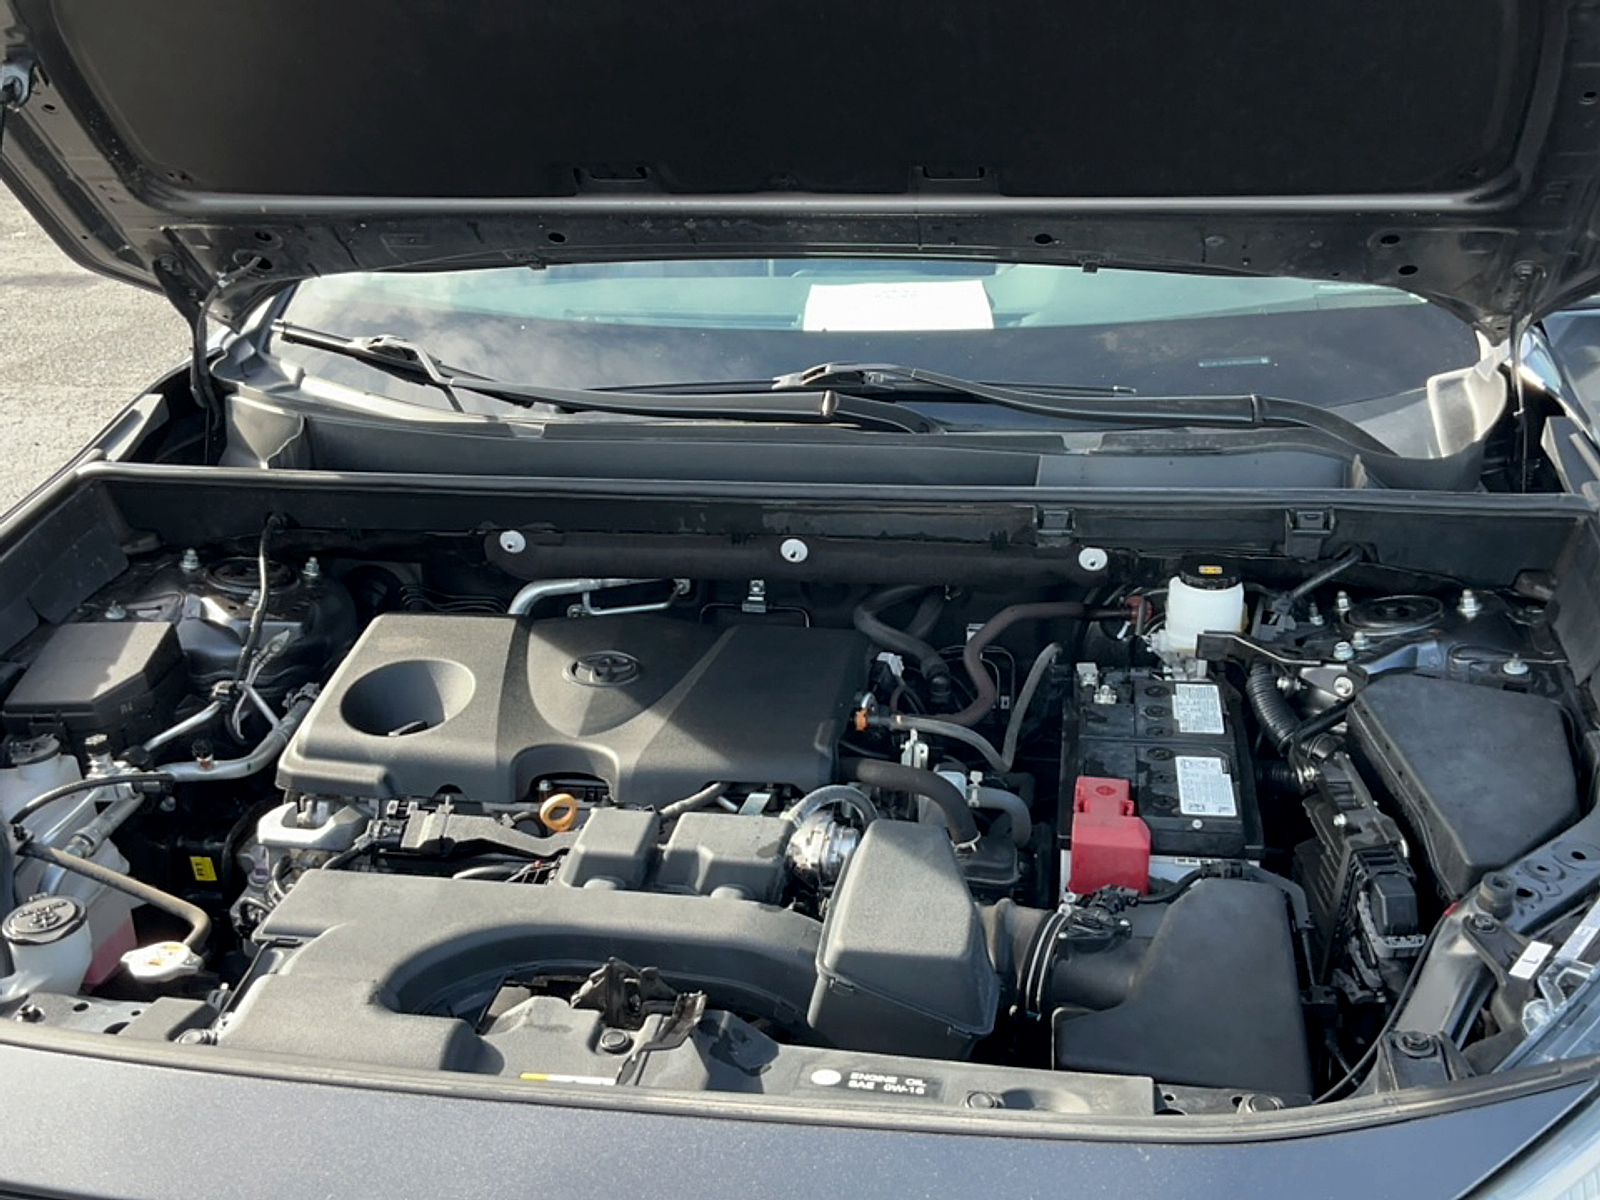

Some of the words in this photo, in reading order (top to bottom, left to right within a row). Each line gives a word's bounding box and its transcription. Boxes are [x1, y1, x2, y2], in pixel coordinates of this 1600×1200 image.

[848, 1080, 875, 1090] SAE
[850, 1072, 898, 1084] ENGINE
[905, 1078, 927, 1087] OIL
